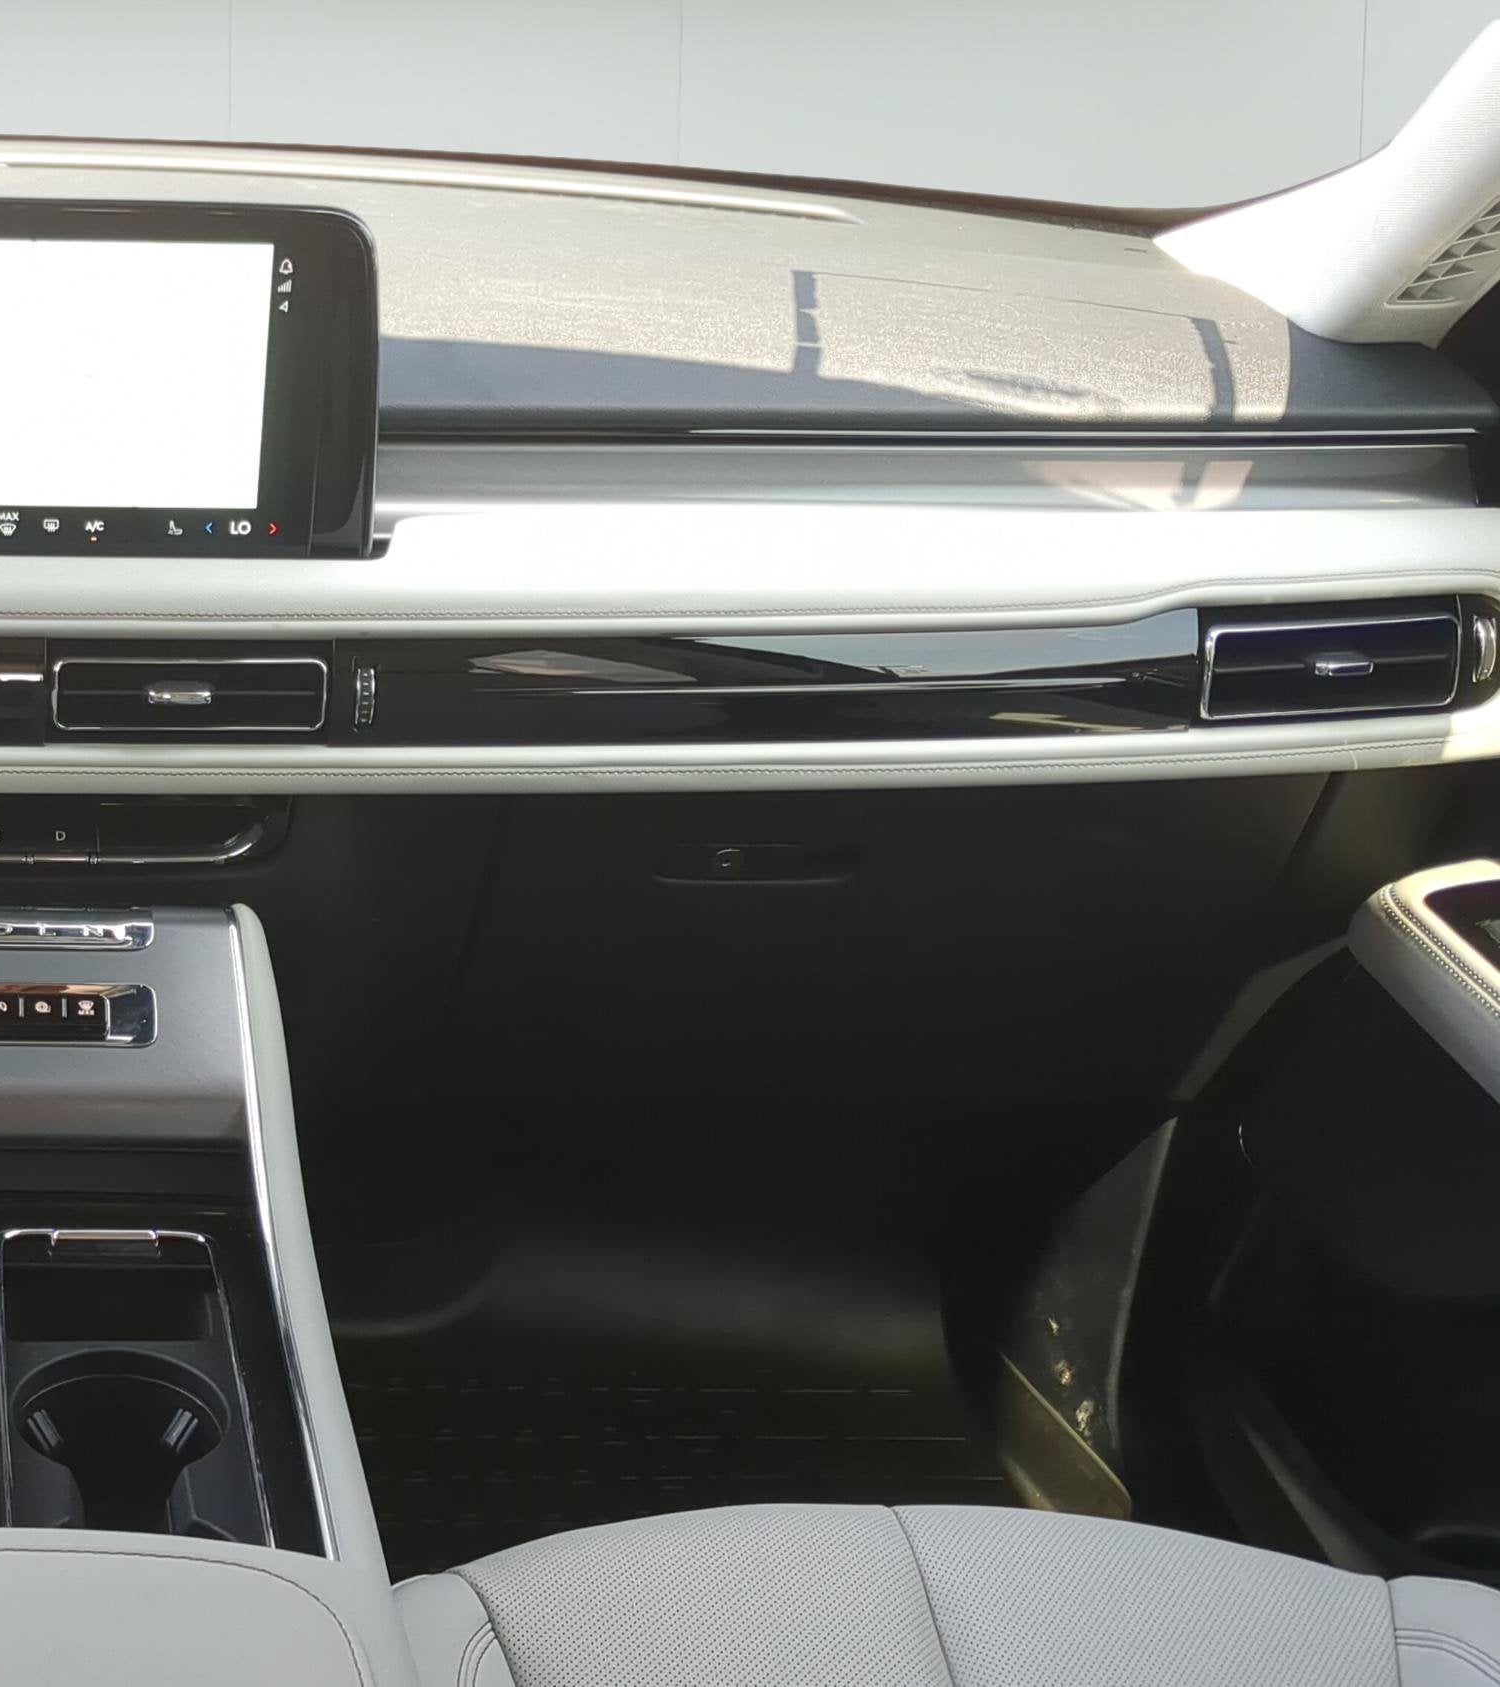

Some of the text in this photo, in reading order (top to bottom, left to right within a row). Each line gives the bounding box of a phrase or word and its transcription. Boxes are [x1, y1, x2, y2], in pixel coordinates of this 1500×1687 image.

[85, 520, 105, 532] A/C
[229, 520, 251, 535] LO
[55, 830, 67, 842] D
